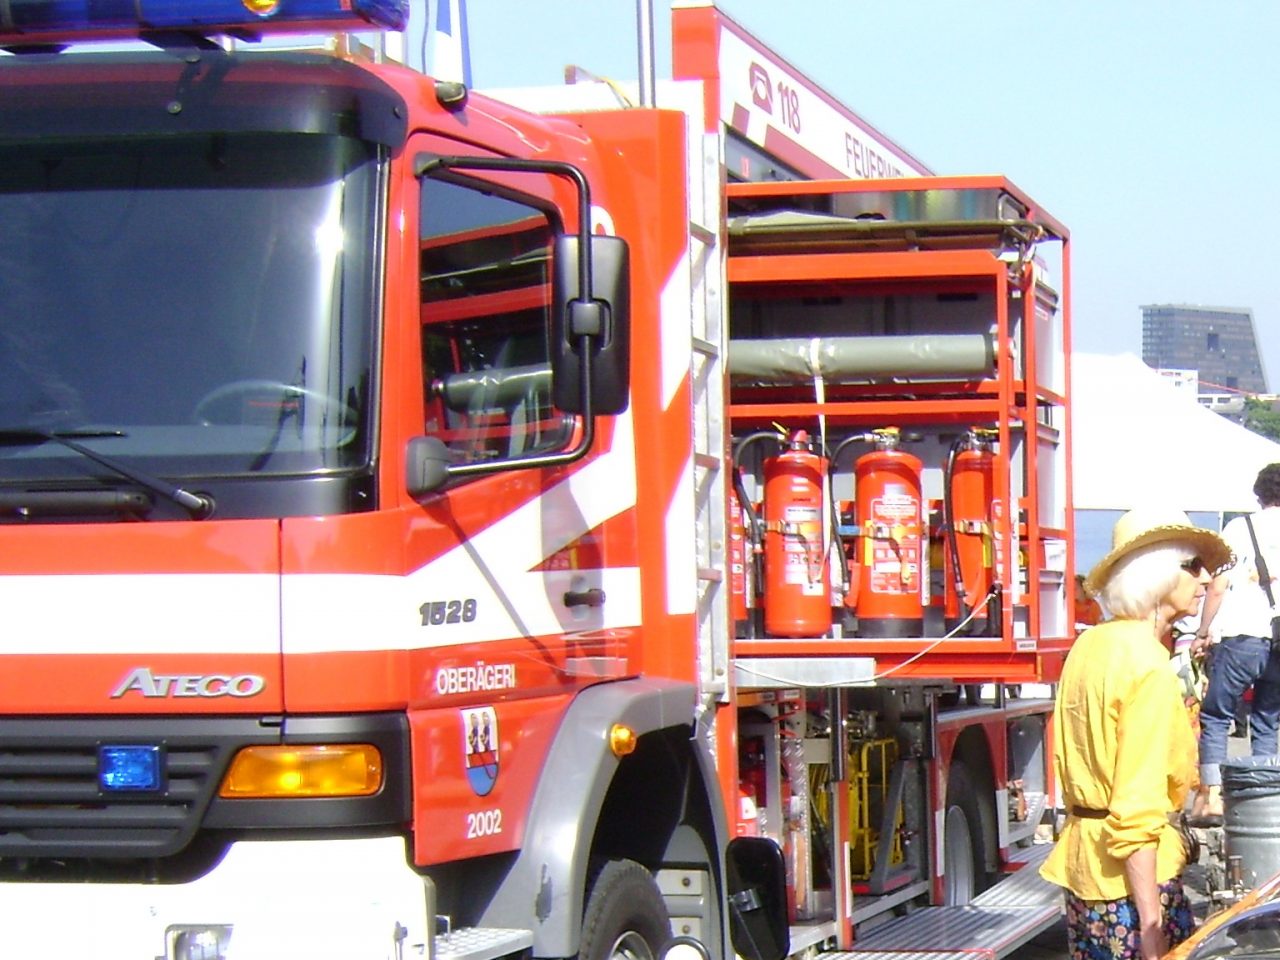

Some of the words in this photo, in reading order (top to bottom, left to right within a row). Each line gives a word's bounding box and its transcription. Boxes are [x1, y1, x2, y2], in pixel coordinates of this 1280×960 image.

[777, 81, 800, 134] 118
[419, 598, 477, 626] 1528
[436, 660, 516, 694] OBERÄGERI
[467, 808, 502, 839] 2002
